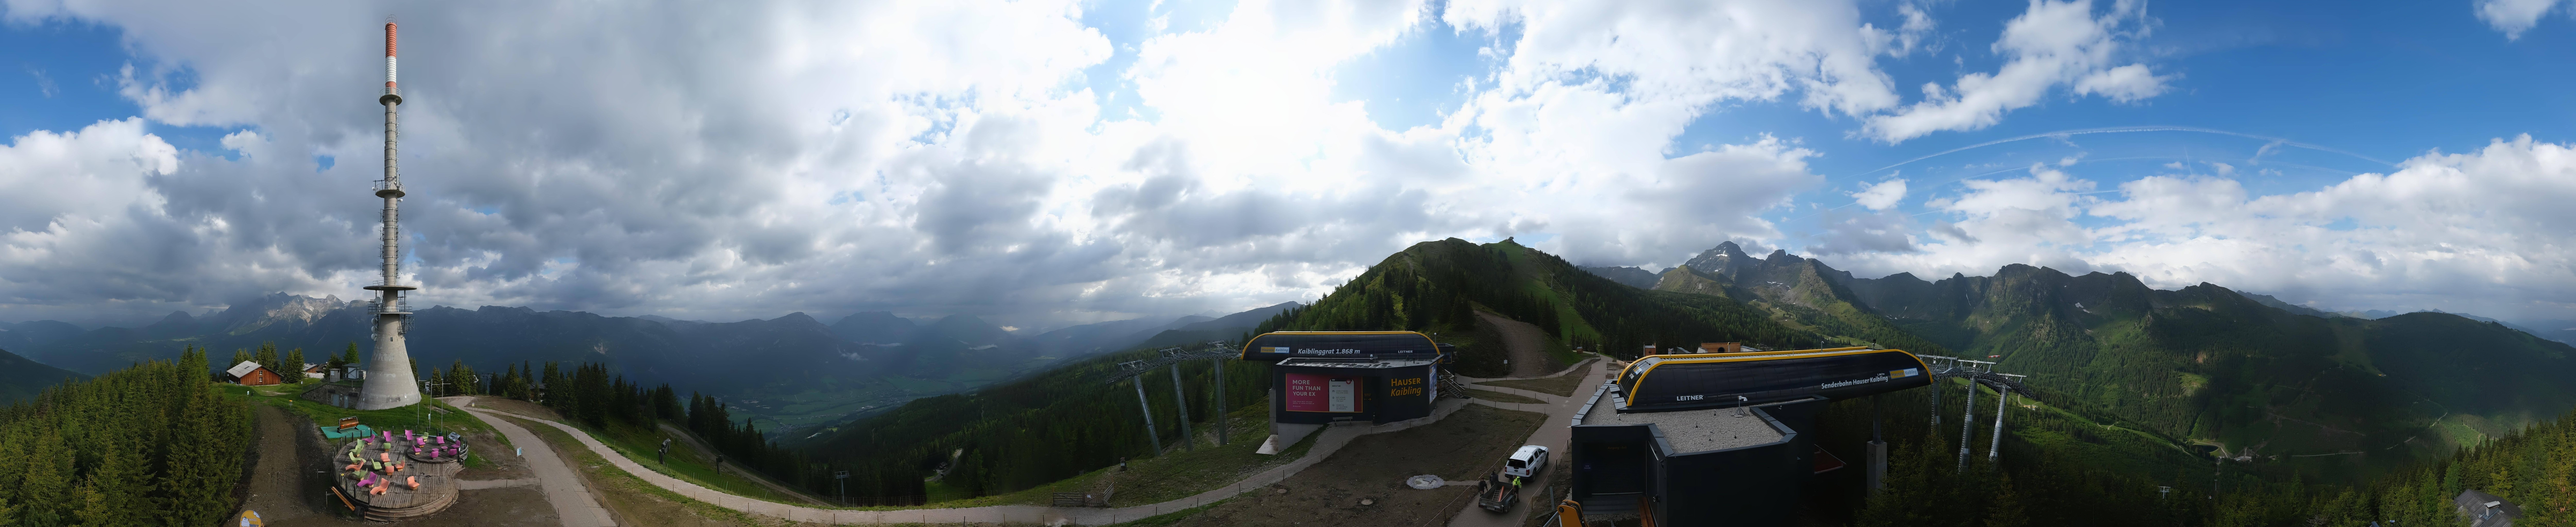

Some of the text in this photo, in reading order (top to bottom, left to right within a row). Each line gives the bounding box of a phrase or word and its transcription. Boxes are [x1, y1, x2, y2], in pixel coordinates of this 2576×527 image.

[1391, 378, 1421, 386] HAUSER
[1821, 379, 1852, 389] Senderbahn
[1391, 387, 1421, 396] Kaibling
